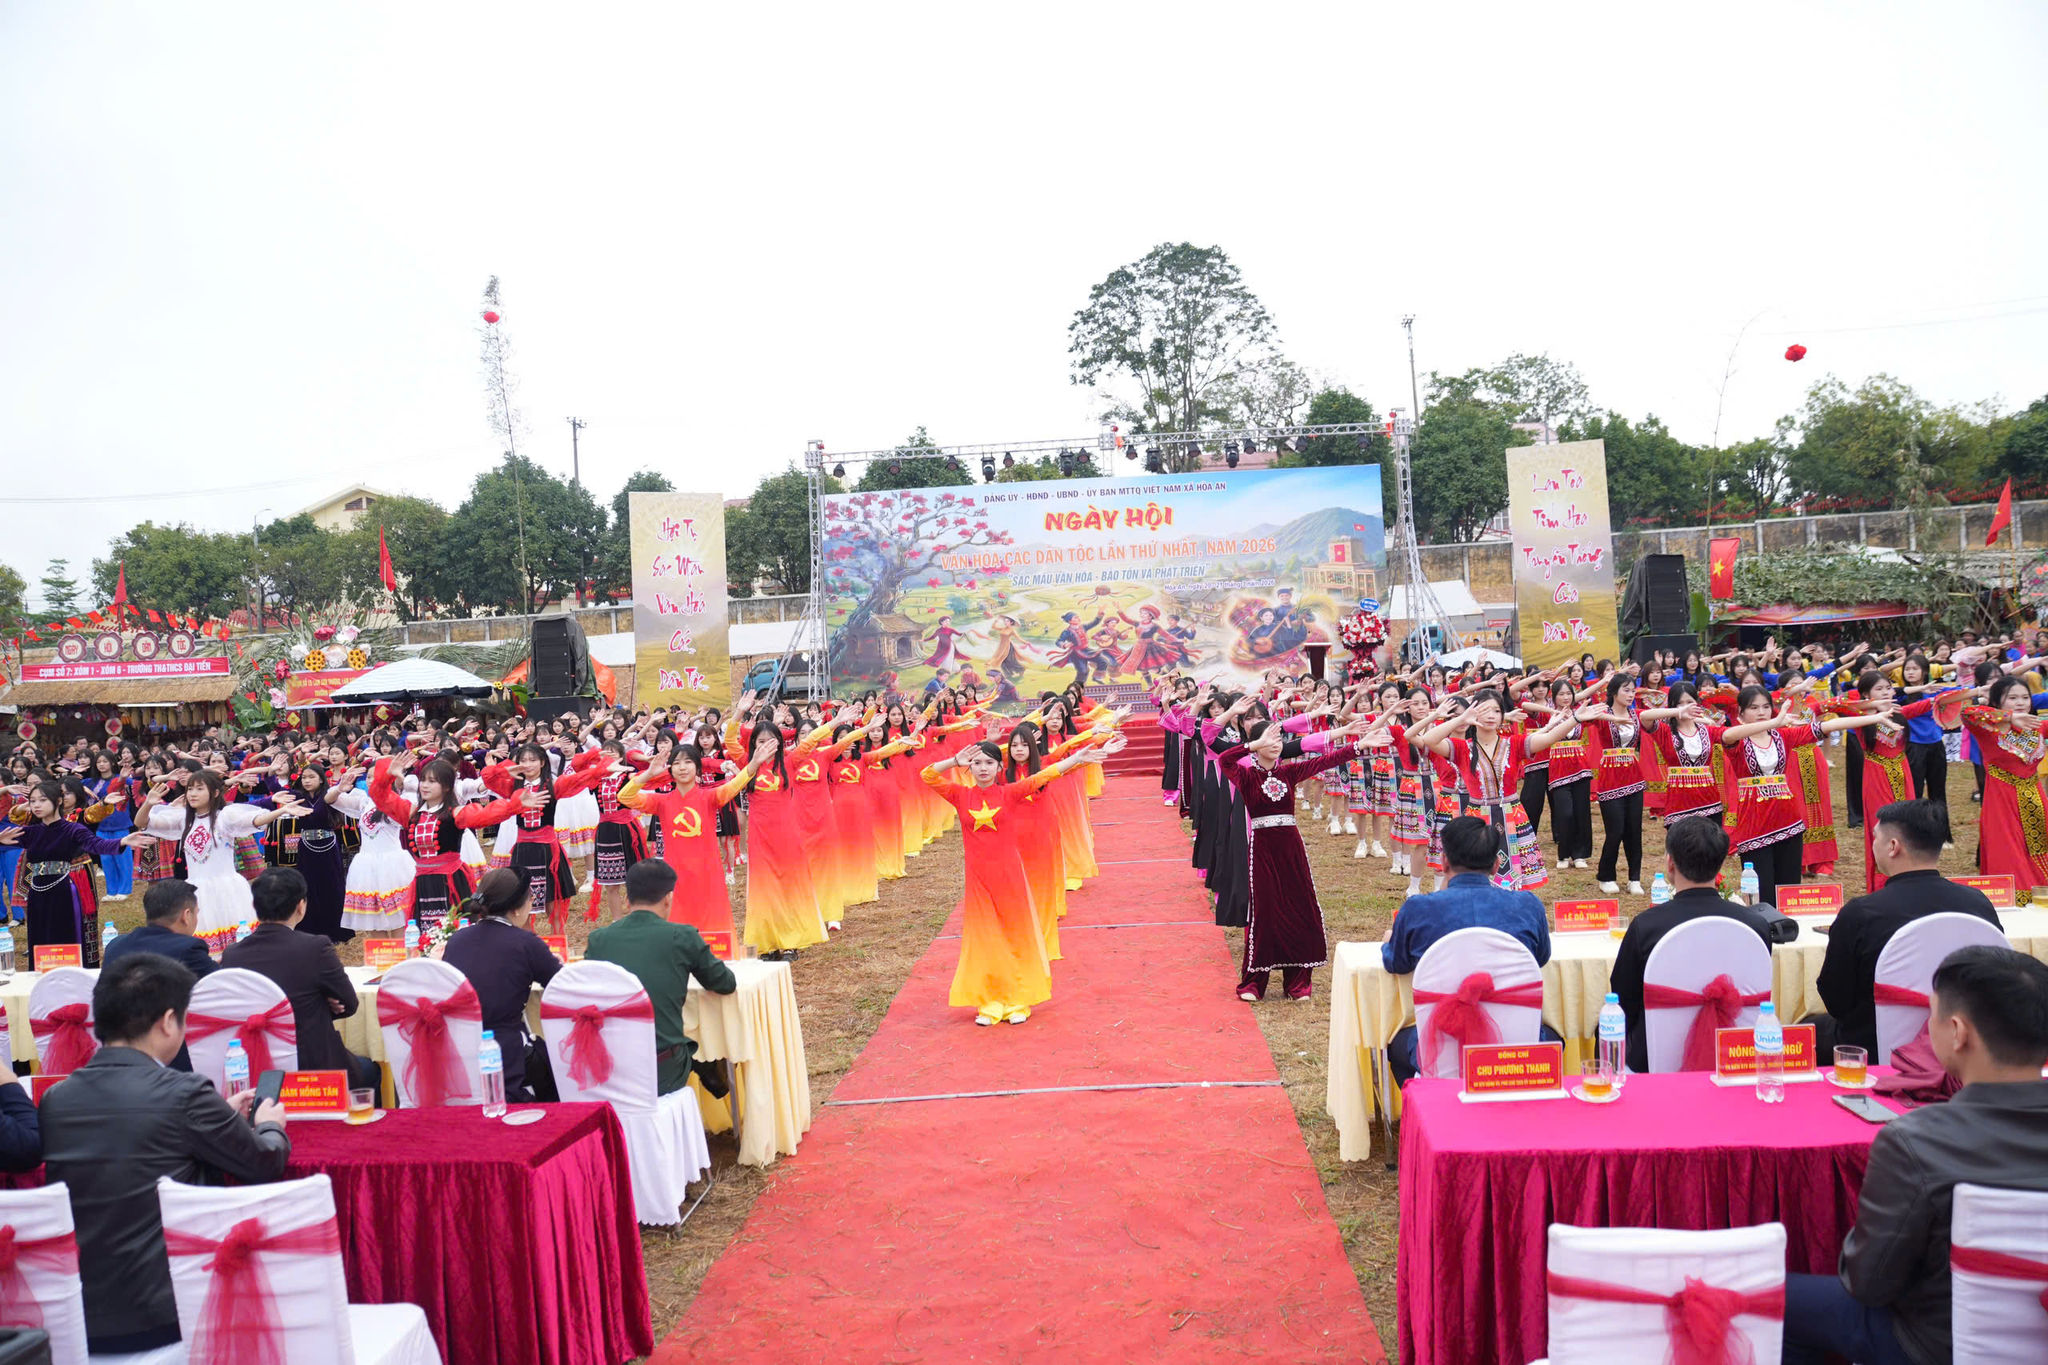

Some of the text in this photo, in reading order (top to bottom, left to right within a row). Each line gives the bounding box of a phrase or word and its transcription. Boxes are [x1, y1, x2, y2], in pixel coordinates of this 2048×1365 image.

[1026, 492, 1049, 500] HĐND
[1056, 490, 1079, 499] UBND
[1099, 488, 1116, 497] BAN
[1119, 486, 1141, 495] MTTQ
[1143, 484, 1160, 494] VIỆT
[1184, 482, 1194, 492] XÃ
[1196, 480, 1213, 491] HÒA
[1215, 482, 1226, 490] AN
[1044, 501, 1173, 531] NGÀY HỘI
[1562, 503, 1589, 529] Hoa
[657, 517, 698, 542] Hội Tụ
[941, 549, 969, 570] VĂN
[1004, 548, 1031, 566] CÁC
[1036, 545, 1063, 564] DÂN
[1068, 544, 1094, 563] TỘC
[1099, 540, 1125, 560] LẦN
[1129, 540, 1157, 559] THỨ
[1163, 537, 1202, 560] NHẤT,
[1207, 538, 1236, 555] NĂM
[1241, 538, 1276, 553] 2026
[1141, 566, 1153, 579] VÀ
[1155, 565, 1177, 578] PHÁT
[1542, 618, 1595, 644] Dân Tộc
[39, 667, 54, 678] CỤM
[56, 665, 65, 677] SỐ
[66, 667, 73, 676] 7:
[74, 665, 89, 676] XÓM
[101, 664, 115, 675] XÓM
[117, 665, 122, 674] 6
[127, 663, 152, 674] TRƯỜNG
[154, 663, 183, 673] TH&THCS
[184, 662, 195, 674] ĐẠI
[196, 659, 211, 671] TIẾN
[659, 667, 709, 691] Dân Tộc
[1729, 1045, 1756, 1058] NÔNG
[1477, 1063, 1550, 1076] CHU PHƯƠNG THANH
[299, 1085, 321, 1097] HỒNG
[323, 1086, 338, 1097] TÂN
